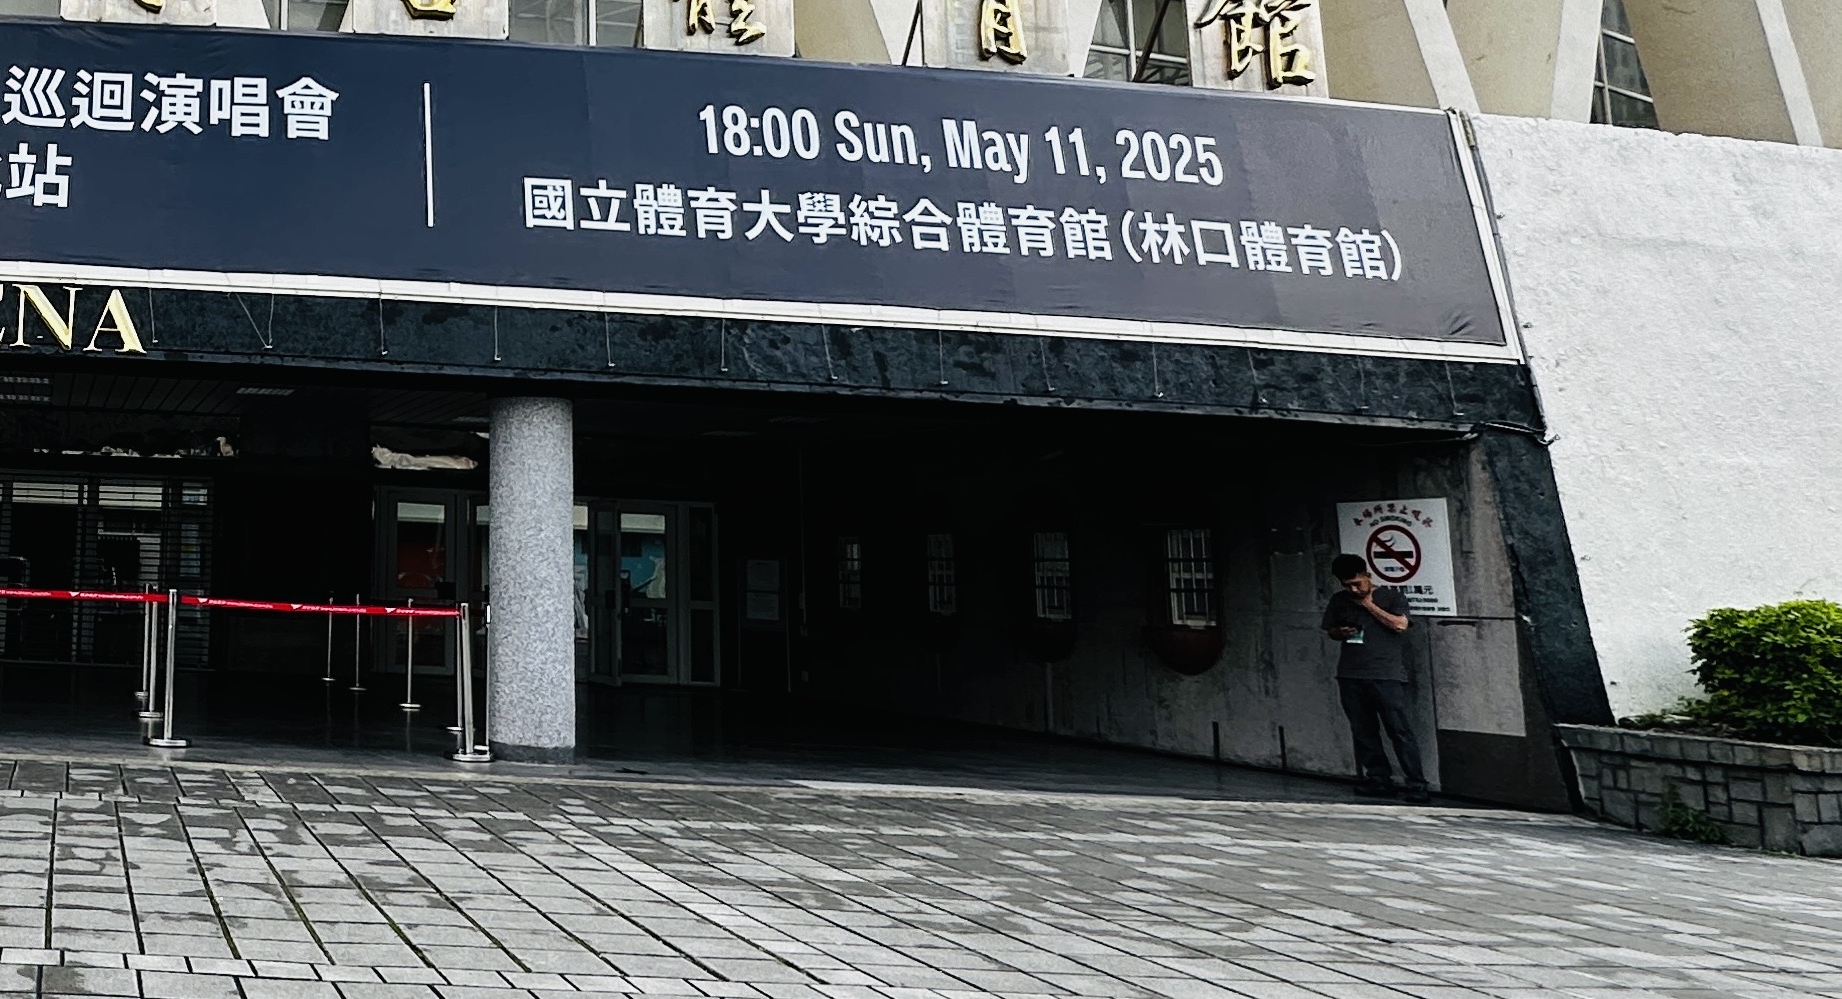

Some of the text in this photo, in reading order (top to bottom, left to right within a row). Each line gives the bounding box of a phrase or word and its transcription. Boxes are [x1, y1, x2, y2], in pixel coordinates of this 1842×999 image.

[699, 104, 1224, 186] 18:00 Sun, May 11, 2025
